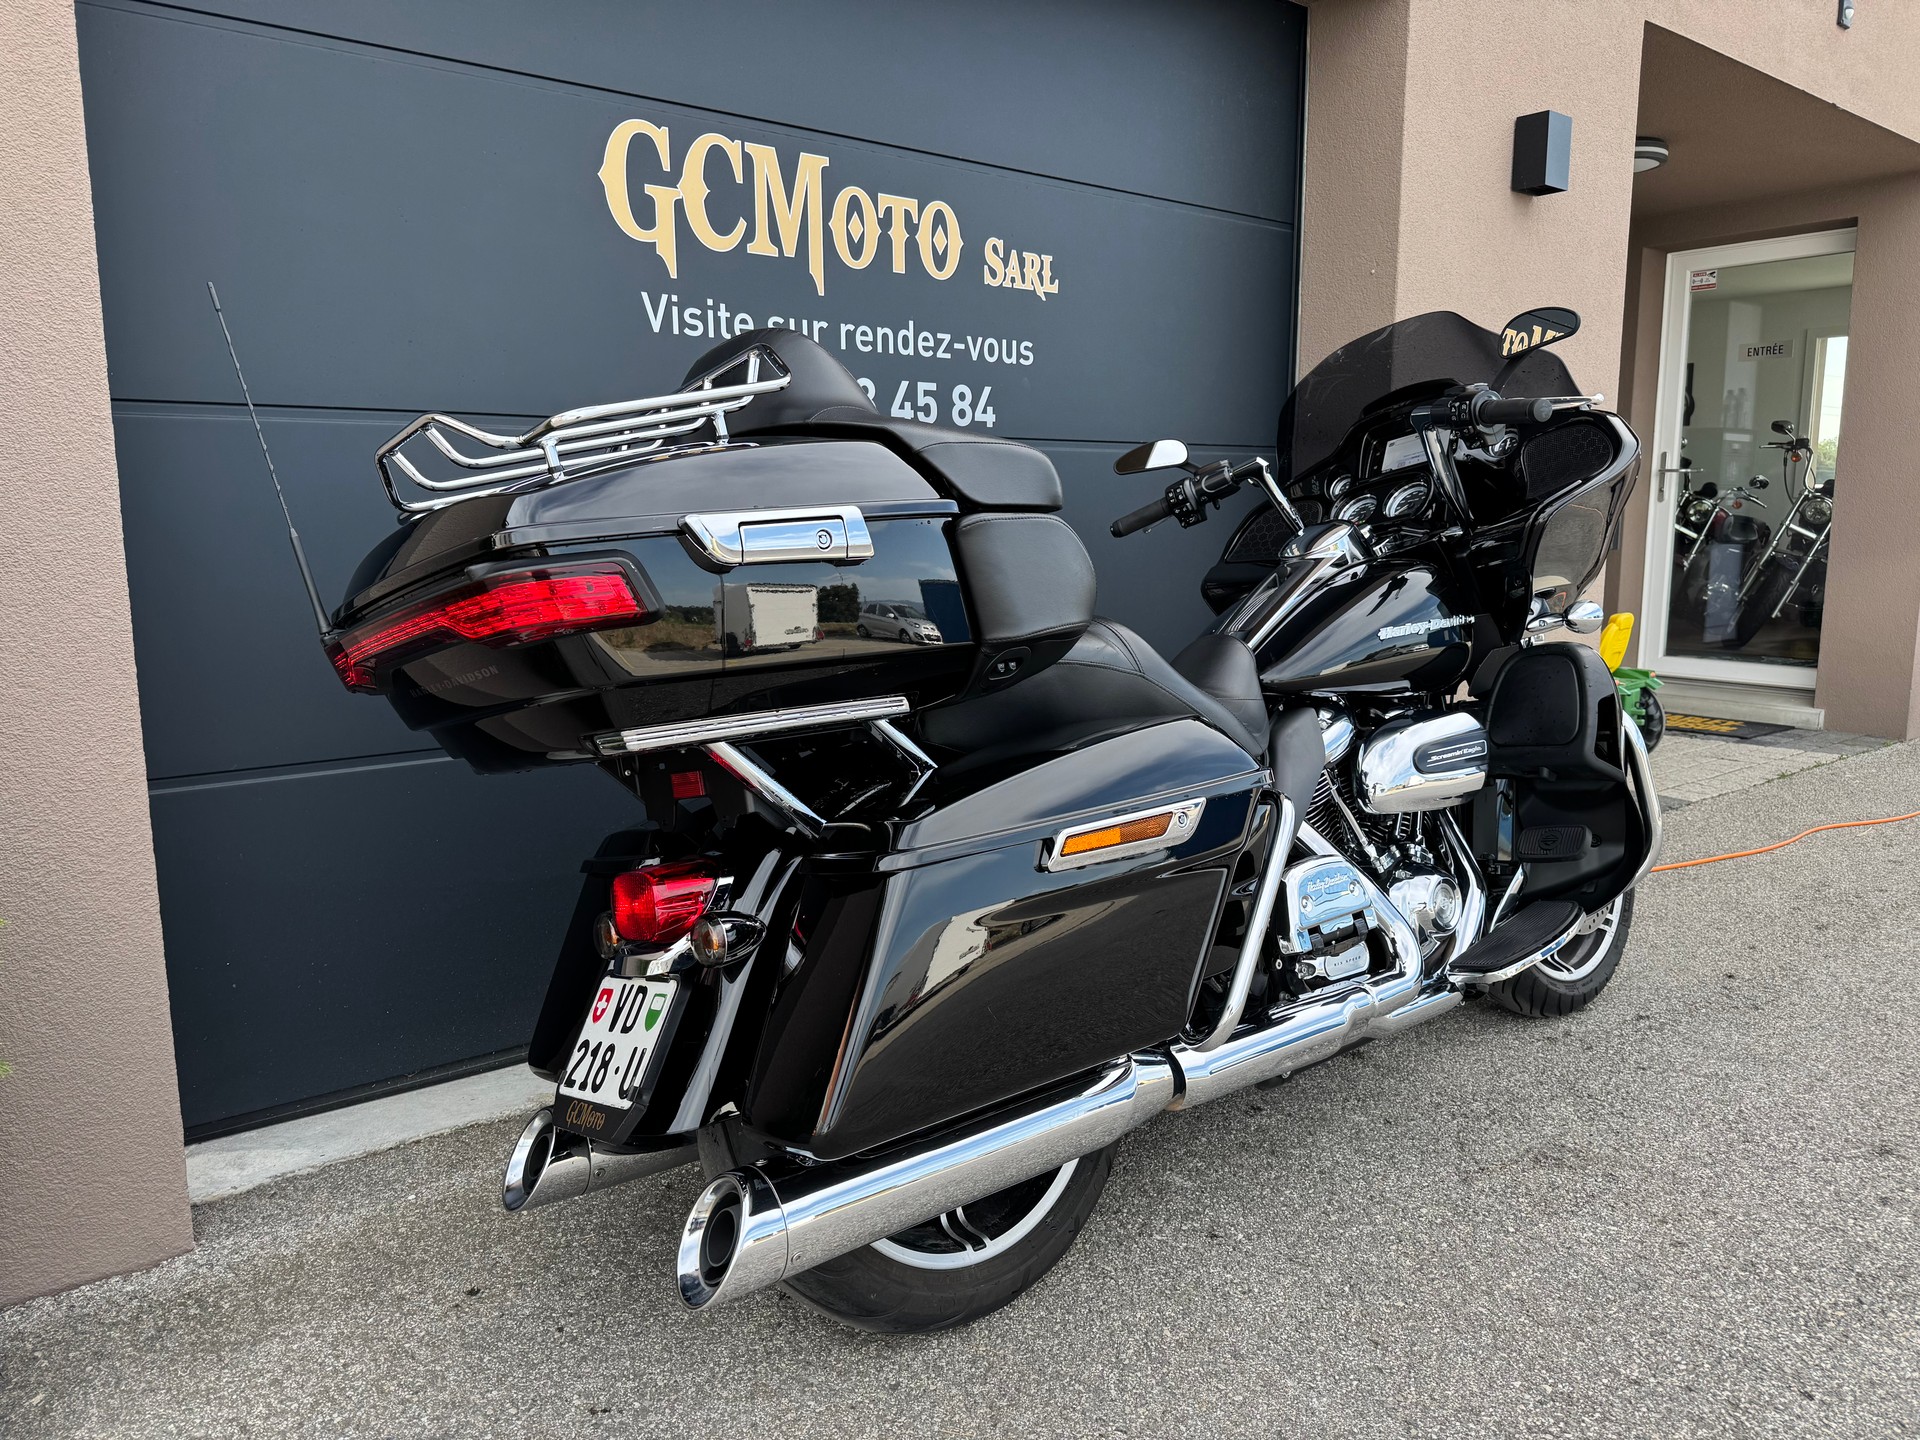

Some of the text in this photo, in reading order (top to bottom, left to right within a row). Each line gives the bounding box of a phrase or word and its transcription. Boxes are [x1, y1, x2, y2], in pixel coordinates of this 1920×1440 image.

[640, 291, 755, 340] Visite
[839, 320, 1035, 366] rendez-vous
[1747, 343, 1784, 357] ENTRÉE
[890, 380, 939, 424] 45
[951, 384, 996, 428] 84
[608, 983, 648, 1034] VD
